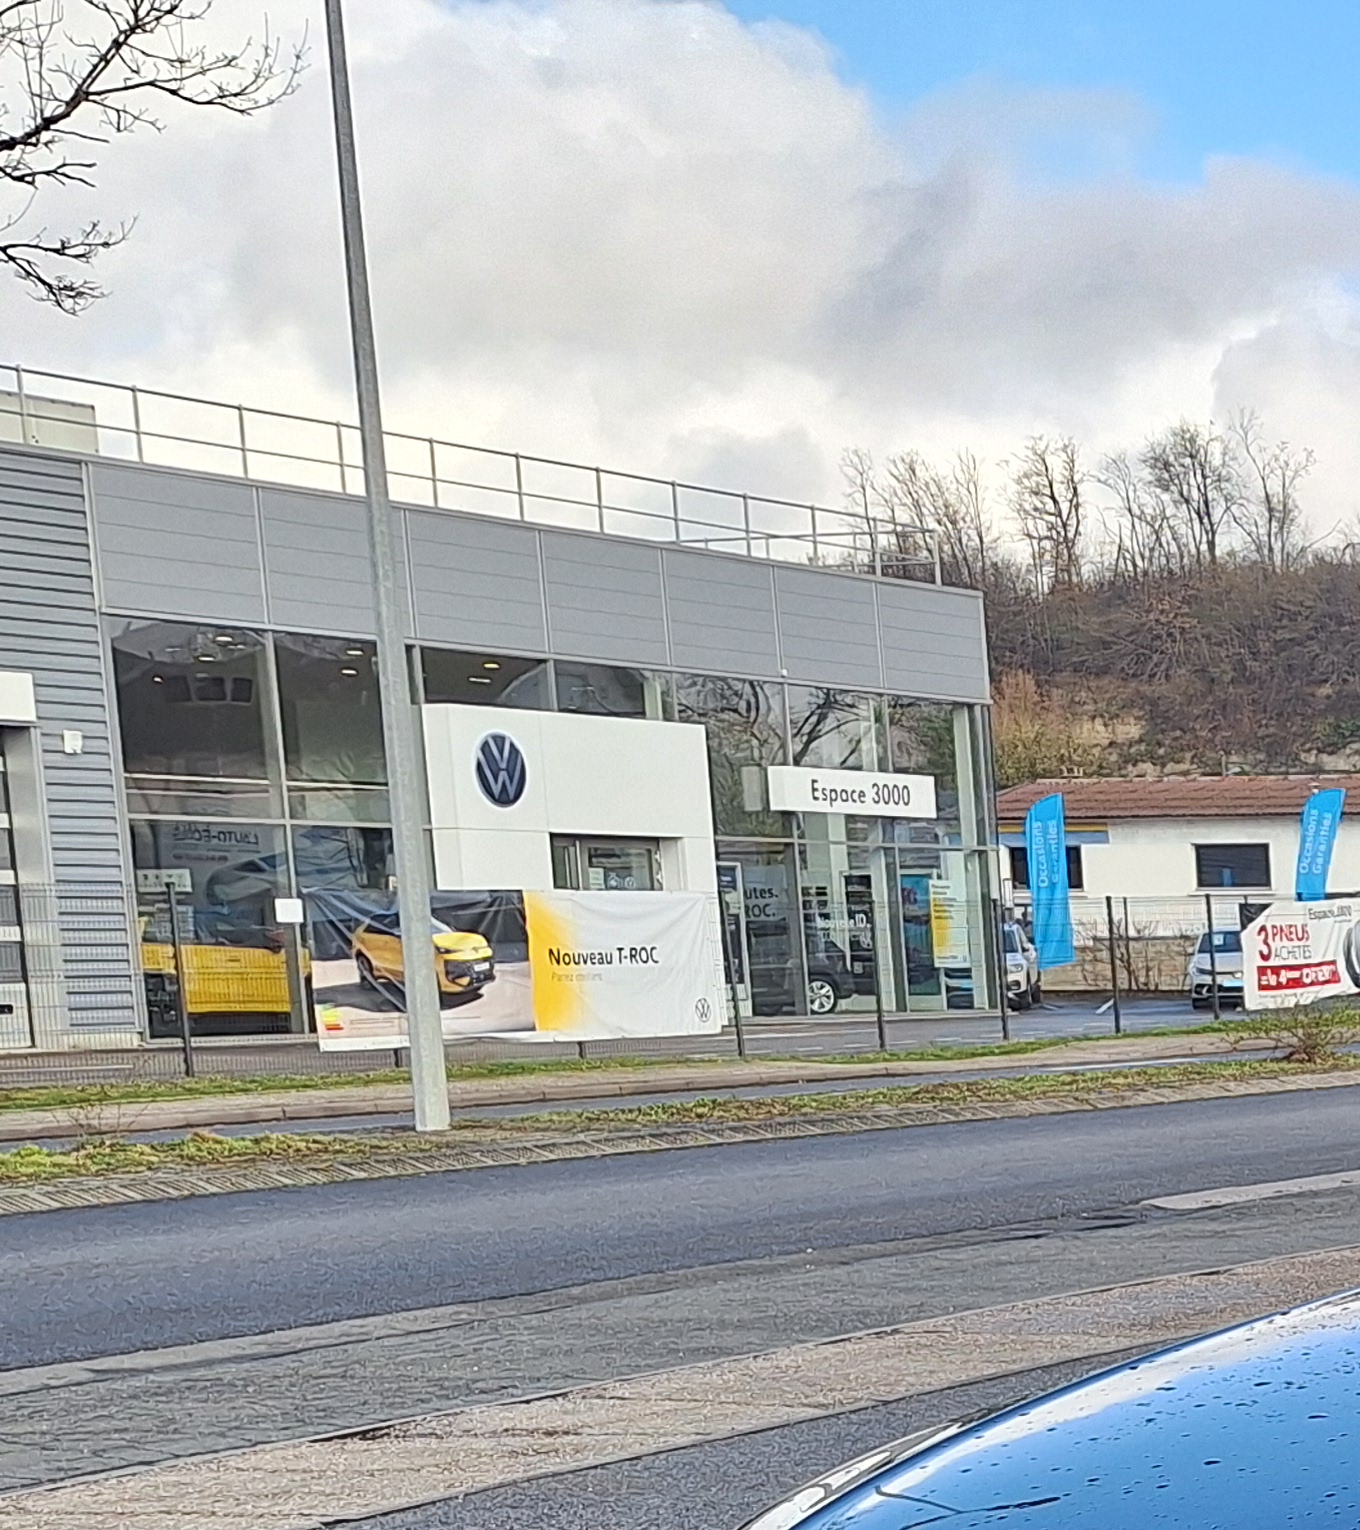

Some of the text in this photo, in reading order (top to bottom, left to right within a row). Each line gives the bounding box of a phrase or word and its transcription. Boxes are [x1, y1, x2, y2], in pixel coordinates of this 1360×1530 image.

[811, 778, 911, 808] Espace 3000
[1033, 820, 1048, 889] Occasions
[1299, 809, 1319, 874] Occasions
[1312, 812, 1333, 874] Garanties
[548, 946, 660, 966] Nouveau T-ROC
[1257, 923, 1310, 962] 3 PNEUS
